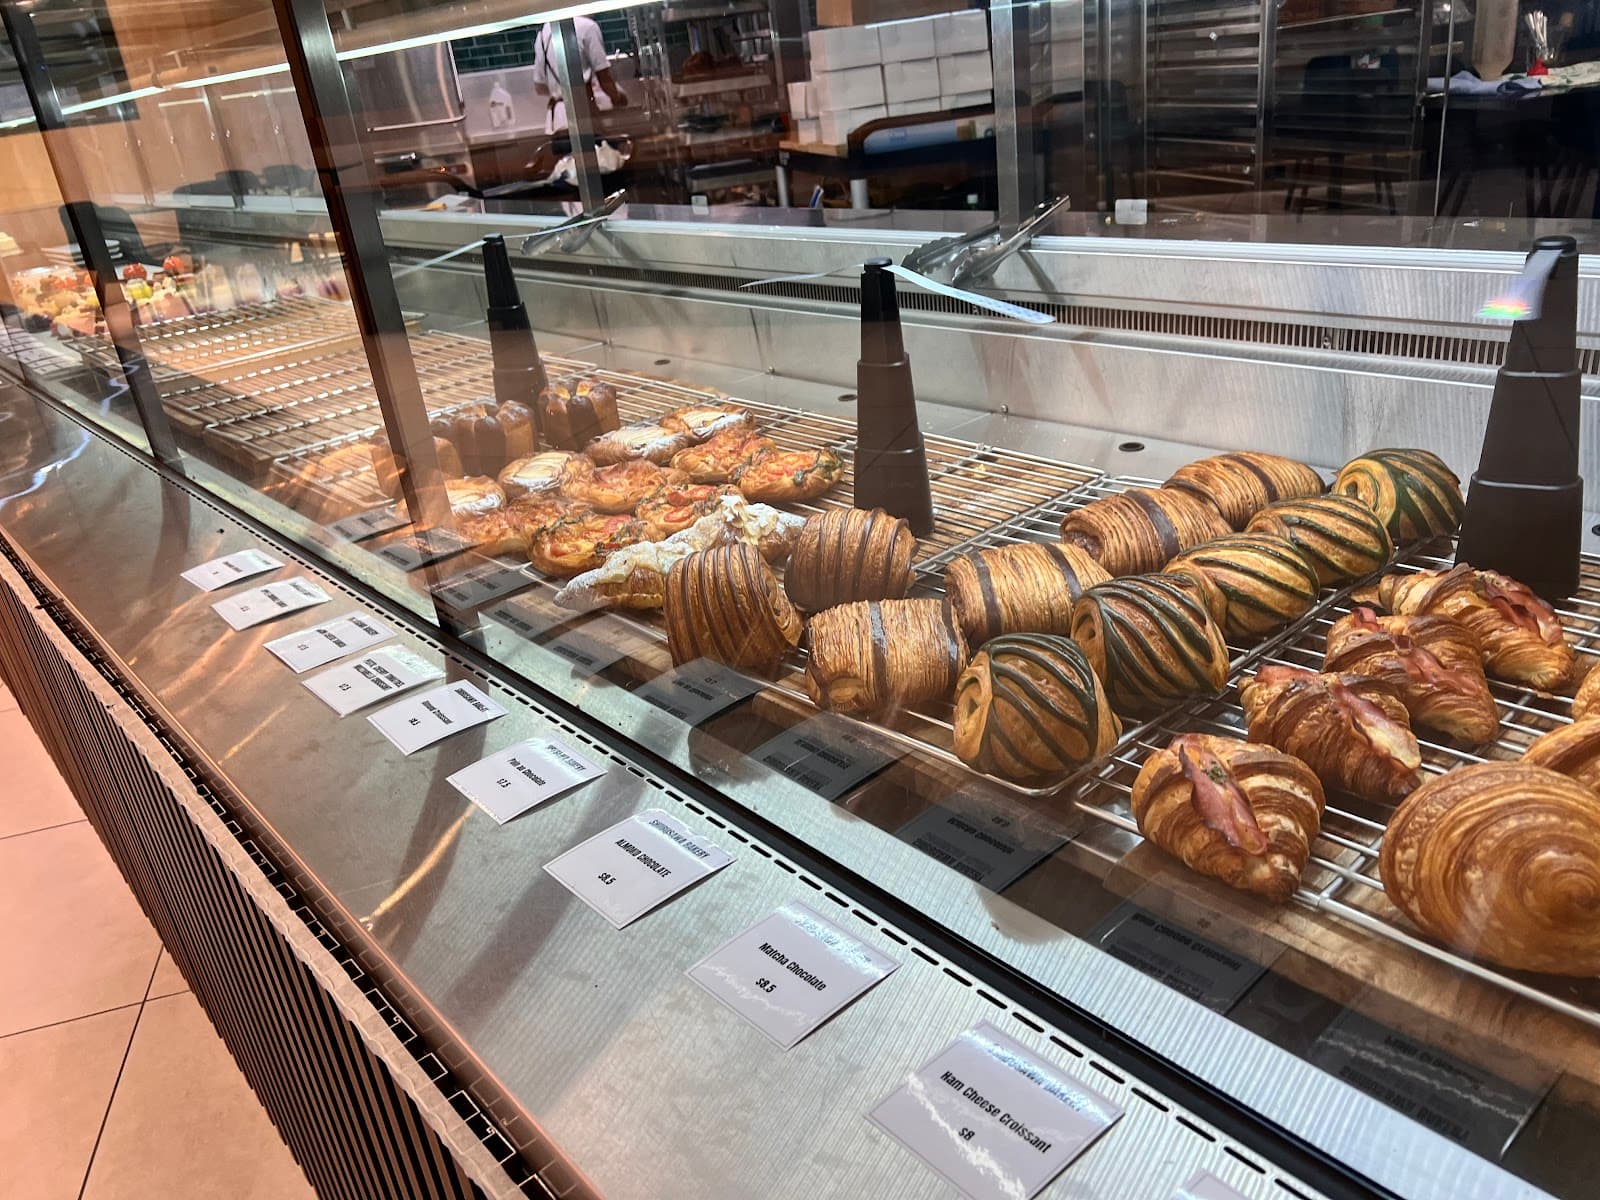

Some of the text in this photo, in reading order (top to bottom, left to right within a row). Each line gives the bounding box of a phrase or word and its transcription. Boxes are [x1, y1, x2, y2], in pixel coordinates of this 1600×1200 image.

[614, 838, 672, 878] ALMOND CHOCOLATE
[682, 841, 710, 859] BAKERY
[598, 871, 617, 886] $8.5
[758, 942, 827, 991] Matcha Chocolate
[755, 977, 777, 993] $8.5
[940, 1071, 1052, 1154] Ham Cheese Croissant
[957, 1126, 976, 1142] $8
